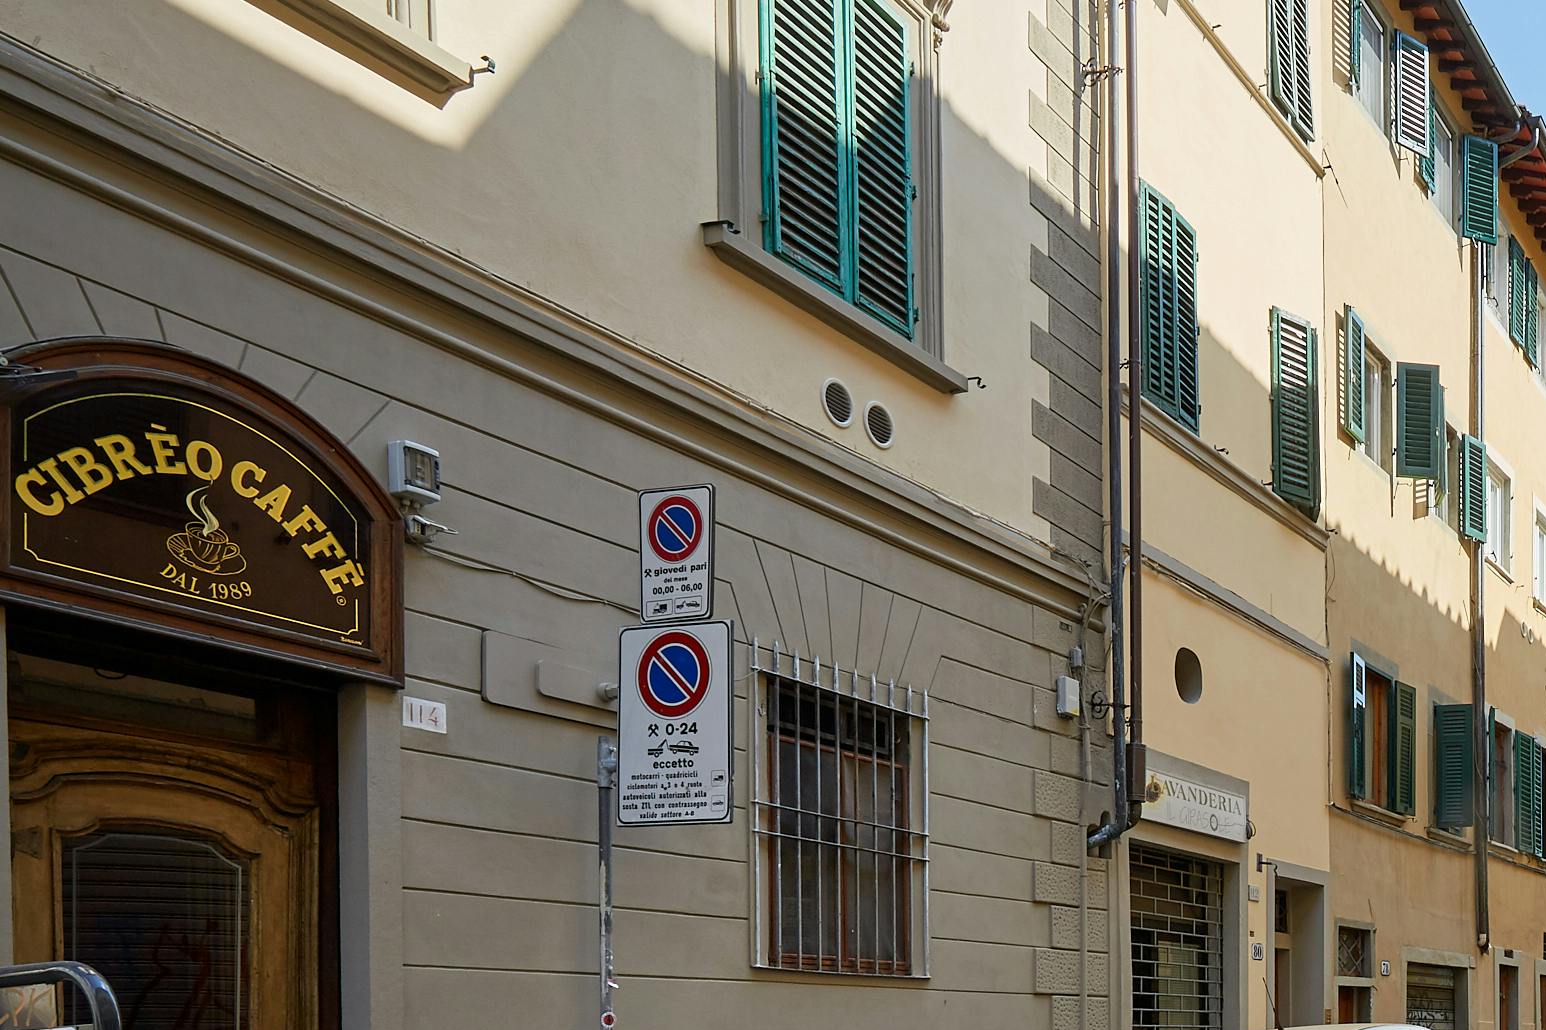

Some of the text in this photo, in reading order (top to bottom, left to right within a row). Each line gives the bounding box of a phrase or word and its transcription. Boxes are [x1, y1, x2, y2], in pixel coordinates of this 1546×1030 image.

[690, 561, 707, 573] pari
[160, 563, 252, 600] DAL 1989
[652, 585, 675, 595] 00,00
[680, 582, 703, 592] 06,00
[409, 702, 439, 726] 114
[665, 721, 698, 736] 0-24
[653, 758, 694, 769] eccetto
[631, 772, 660, 780] motocarri
[665, 771, 698, 779] quadricicli
[687, 780, 702, 788] ruote
[623, 792, 656, 800] autoveicoli
[659, 790, 691, 799] autorizzati
[641, 801, 651, 809] ZTL
[668, 801, 707, 809] contrassegno
[1253, 944, 1262, 958] 80
